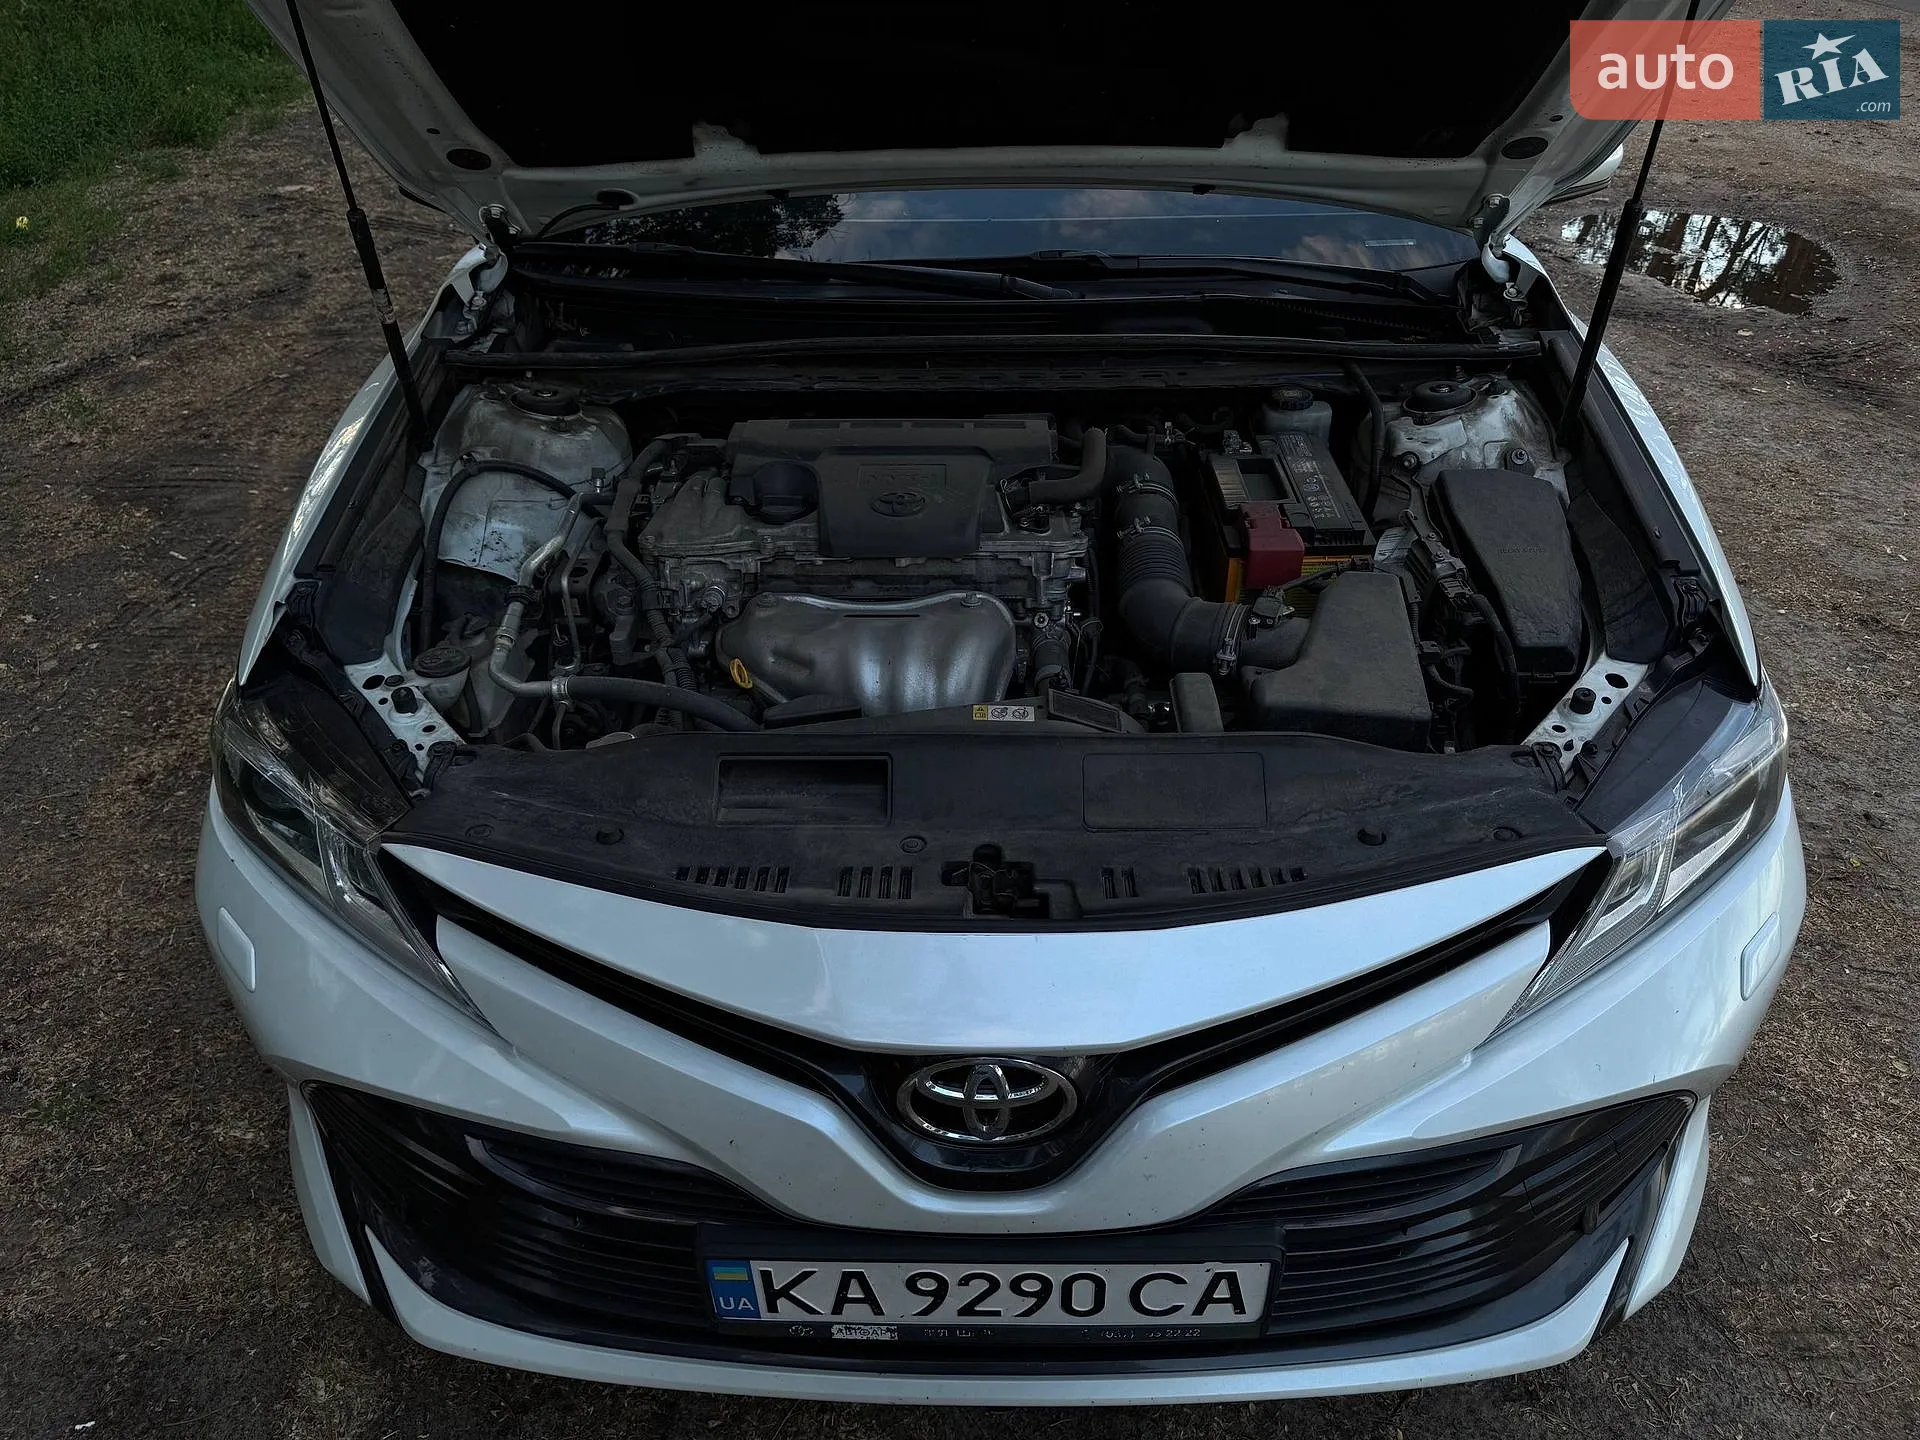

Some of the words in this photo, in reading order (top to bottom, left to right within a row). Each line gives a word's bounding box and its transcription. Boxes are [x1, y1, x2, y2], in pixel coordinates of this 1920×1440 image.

[718, 1296, 755, 1311] UA
[758, 1269, 887, 1316] KA
[904, 1269, 1107, 1317] 9290
[1128, 1269, 1248, 1317] CA
